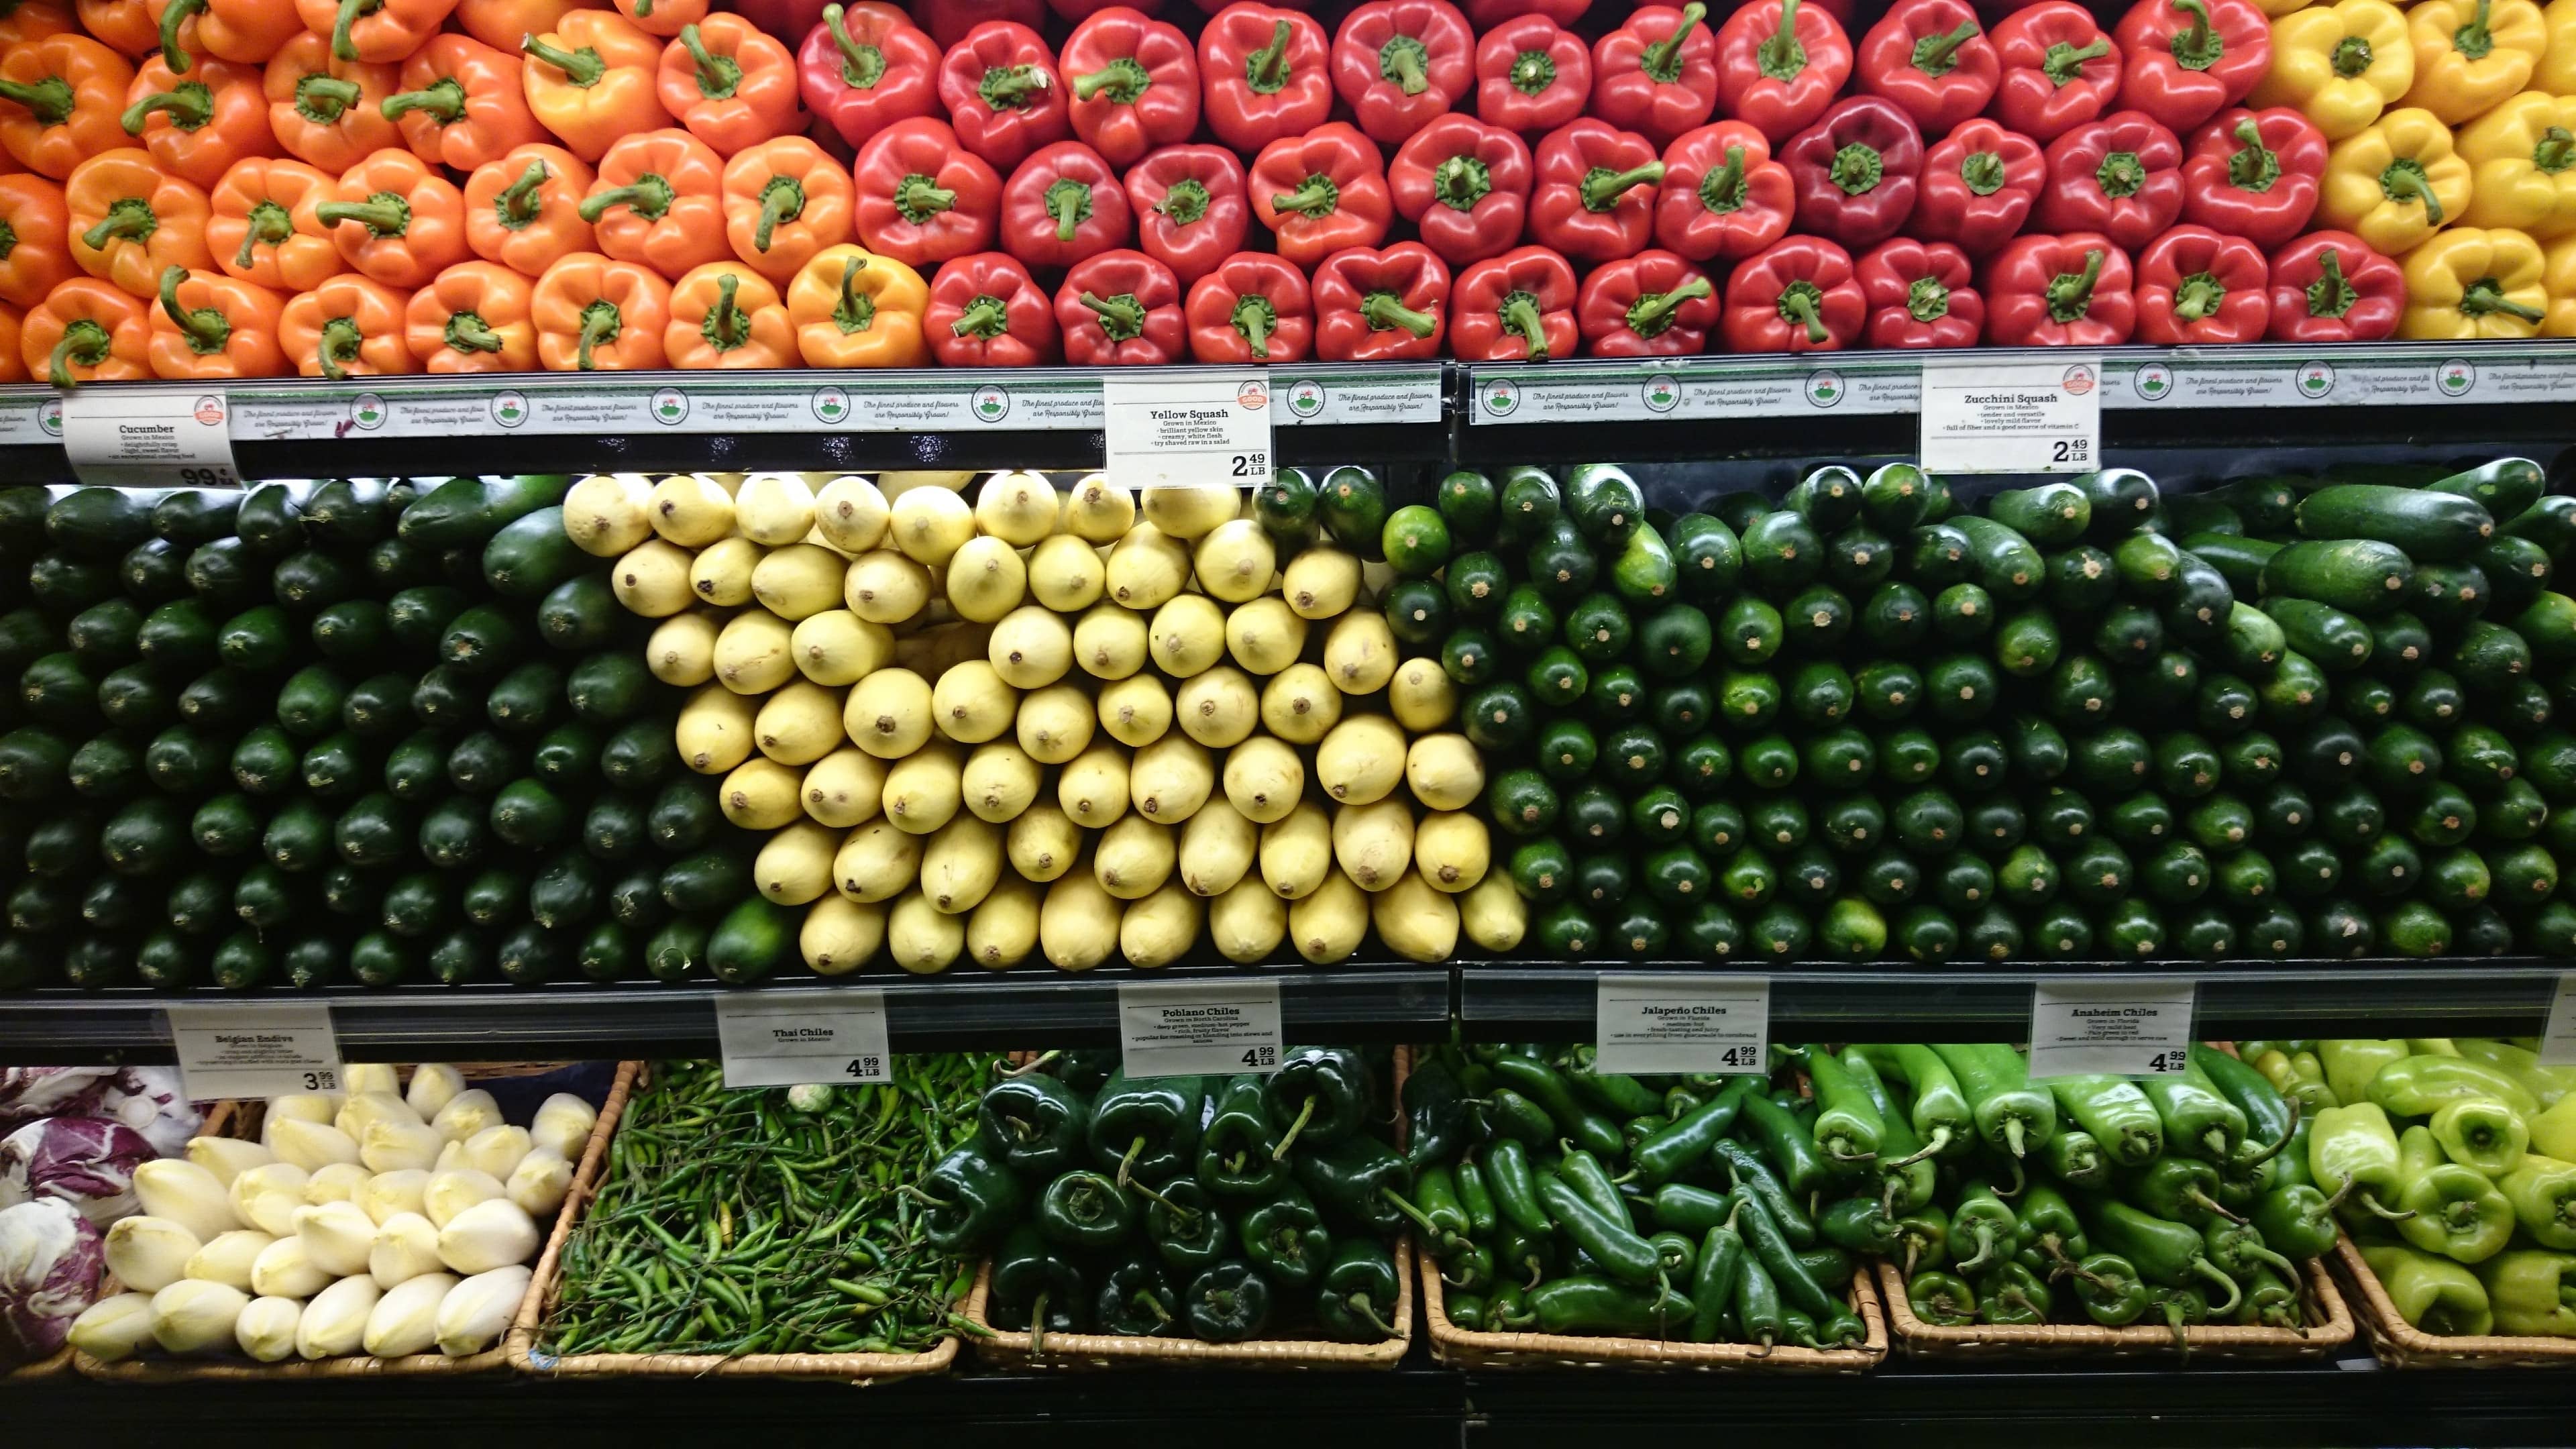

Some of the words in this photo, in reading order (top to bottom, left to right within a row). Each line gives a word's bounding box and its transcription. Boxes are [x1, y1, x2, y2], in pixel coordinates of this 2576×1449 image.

[1351, 394, 1369, 402] finest
[1409, 393, 1433, 401] flowers
[1533, 392, 1545, 400] The
[1546, 392, 1564, 402] finest
[1564, 392, 1590, 400] produce
[1605, 392, 1628, 400] flowers
[1965, 394, 2015, 403] Zucchini
[2017, 394, 2057, 405] Squash
[877, 401, 894, 410] finest
[896, 401, 921, 409] produce
[935, 401, 959, 410] flowers
[1035, 400, 1053, 408] finest
[1360, 404, 1396, 413] Responsibly
[1397, 403, 1423, 412] Grown!
[1556, 402, 1591, 411] Responsibly
[1593, 402, 1618, 411] Grown!
[887, 411, 922, 421] Responsibly
[924, 411, 949, 419] Grown!
[1045, 409, 1080, 419] Responsibly
[1081, 410, 1104, 418] Grown
[1150, 411, 1187, 419] Yellow
[1190, 409, 1228, 420] Squash
[119, 425, 174, 433] Cucumber
[2053, 441, 2070, 462] 2
[2071, 439, 2088, 449] 49
[2072, 453, 2088, 461] LB
[1232, 455, 1248, 476] 2
[1249, 453, 1265, 464] 49
[1250, 467, 1265, 475] LB
[181, 468, 216, 486] 99
[1163, 1009, 1205, 1017] Poblano
[1642, 1006, 1690, 1016] Jalapeño
[1693, 1006, 1726, 1014] Chiles
[215, 1036, 254, 1044] Belgian
[256, 1034, 294, 1042] Endive
[1242, 1049, 1258, 1066] 4
[1259, 1047, 1274, 1055] 99
[1721, 1048, 1738, 1066] 4
[1741, 1046, 1756, 1055] 99
[2149, 1053, 2167, 1072] 4
[2169, 1051, 2186, 1060] 99
[846, 1059, 863, 1077] 4
[863, 1057, 879, 1065] 99
[303, 1073, 319, 1090] 3
